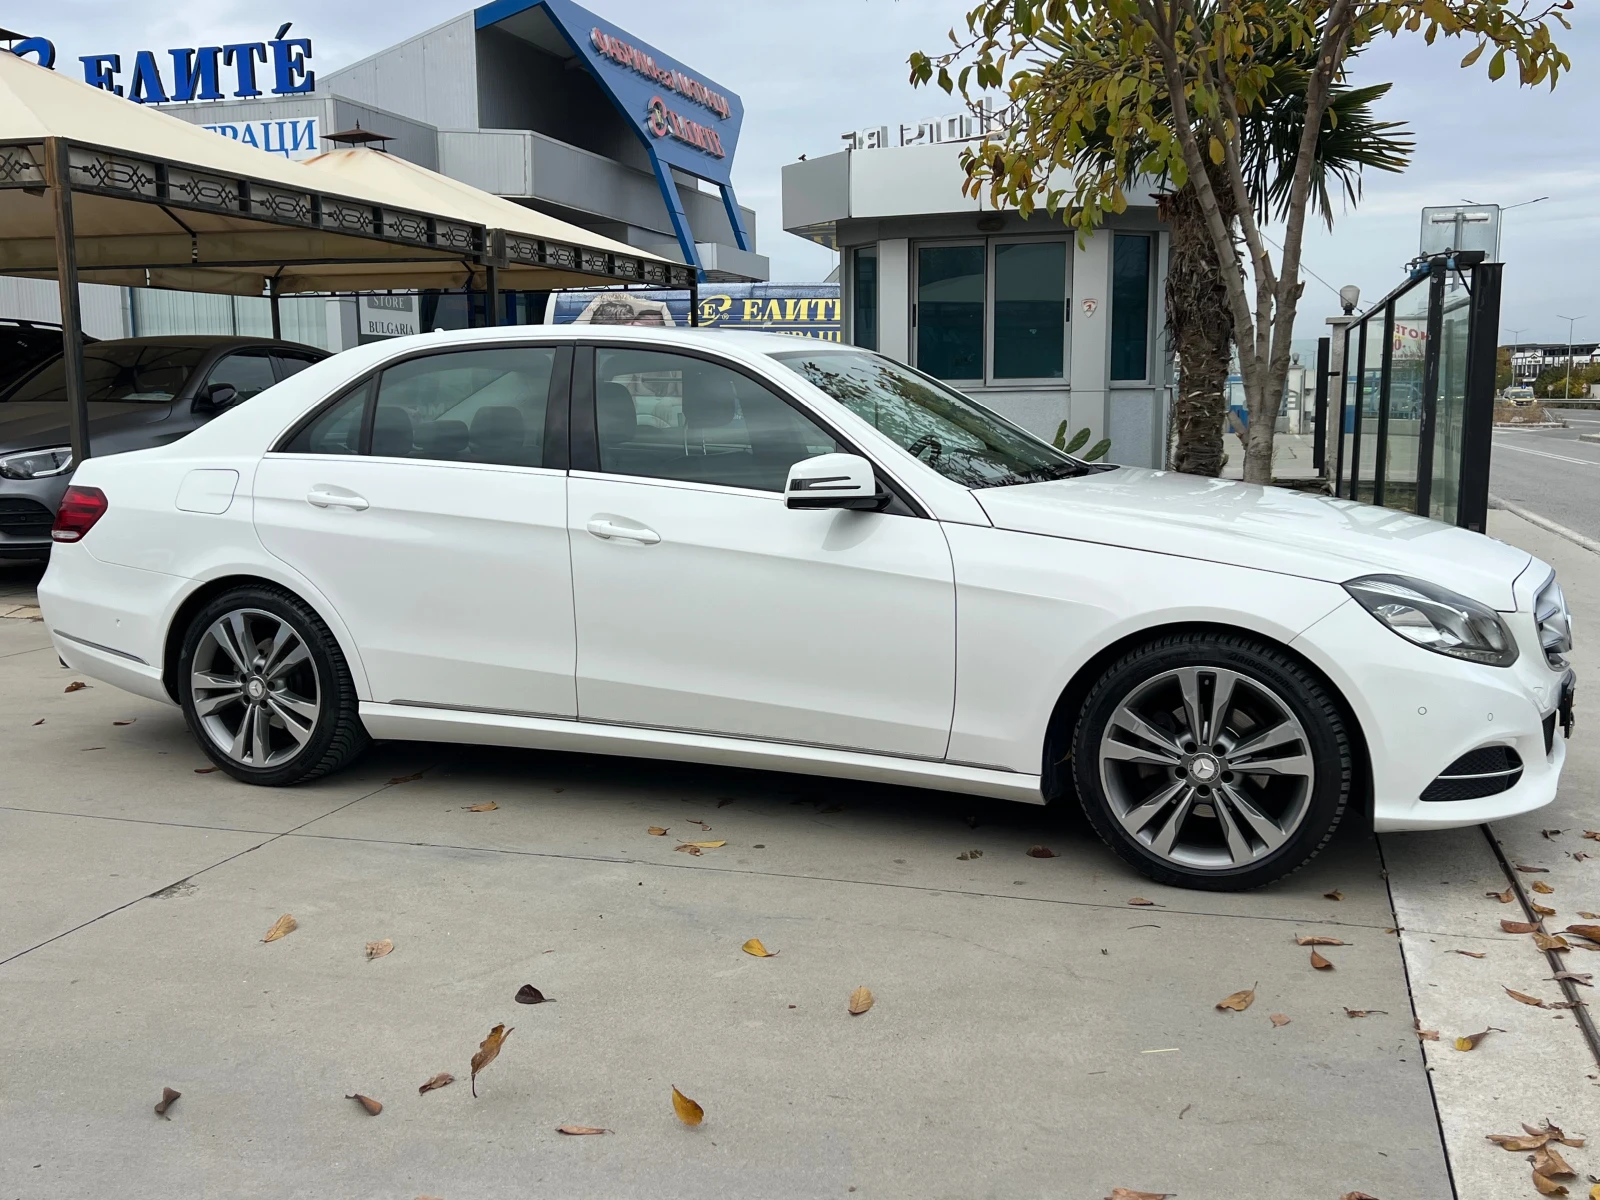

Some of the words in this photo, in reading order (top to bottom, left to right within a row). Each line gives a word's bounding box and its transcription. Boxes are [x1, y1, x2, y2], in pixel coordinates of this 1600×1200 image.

[202, 120, 318, 158] РАЦИ
[373, 295, 405, 309] STORE
[369, 320, 415, 336] BULGARIA
